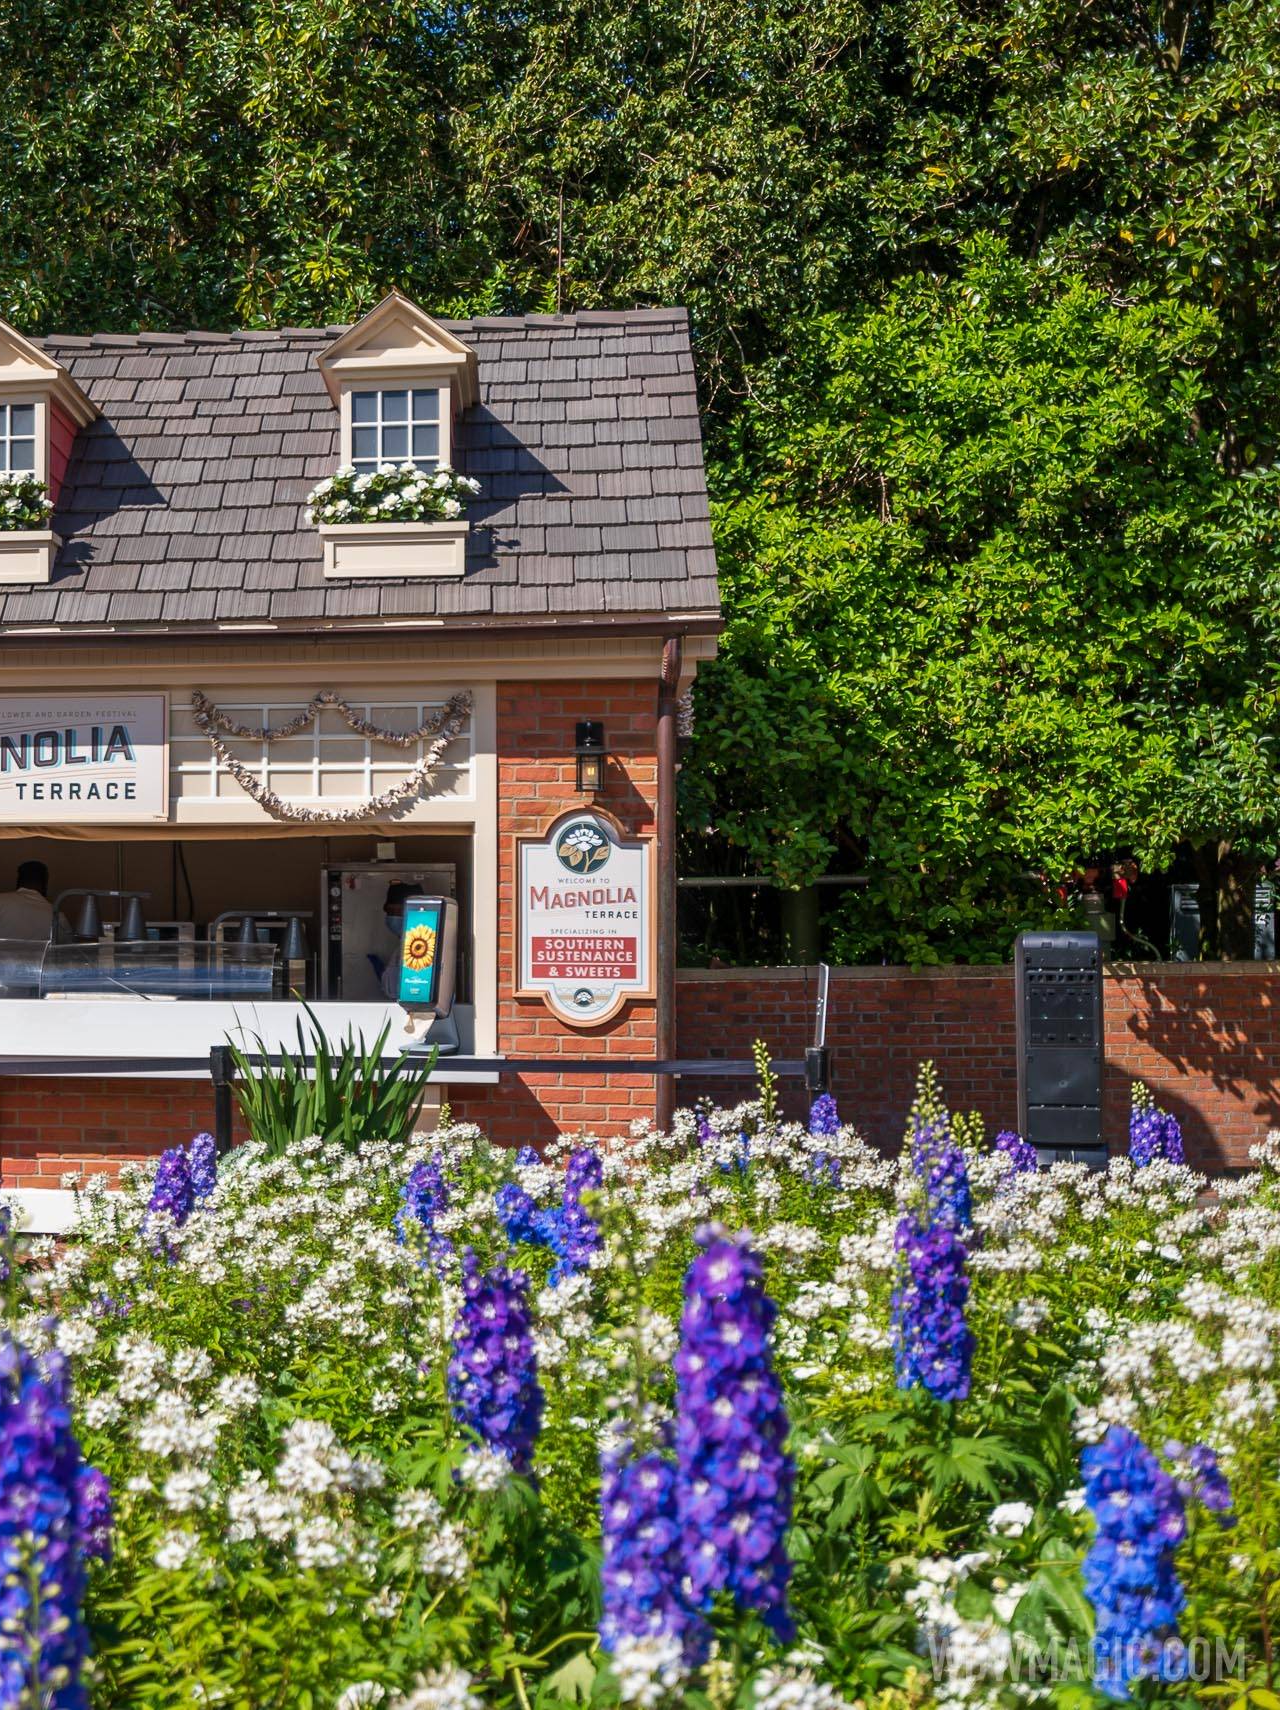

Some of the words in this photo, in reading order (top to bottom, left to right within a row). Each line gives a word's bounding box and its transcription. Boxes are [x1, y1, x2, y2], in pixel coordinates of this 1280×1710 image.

[95, 710, 137, 718] FESTIVAL
[16, 782, 137, 800] TERRACE
[585, 910, 638, 919] TERRACE
[545, 938, 625, 950] SOUTHERN
[537, 950, 633, 962] SUSTENANCE
[548, 966, 558, 977] &
[567, 966, 621, 978] SWEETS
